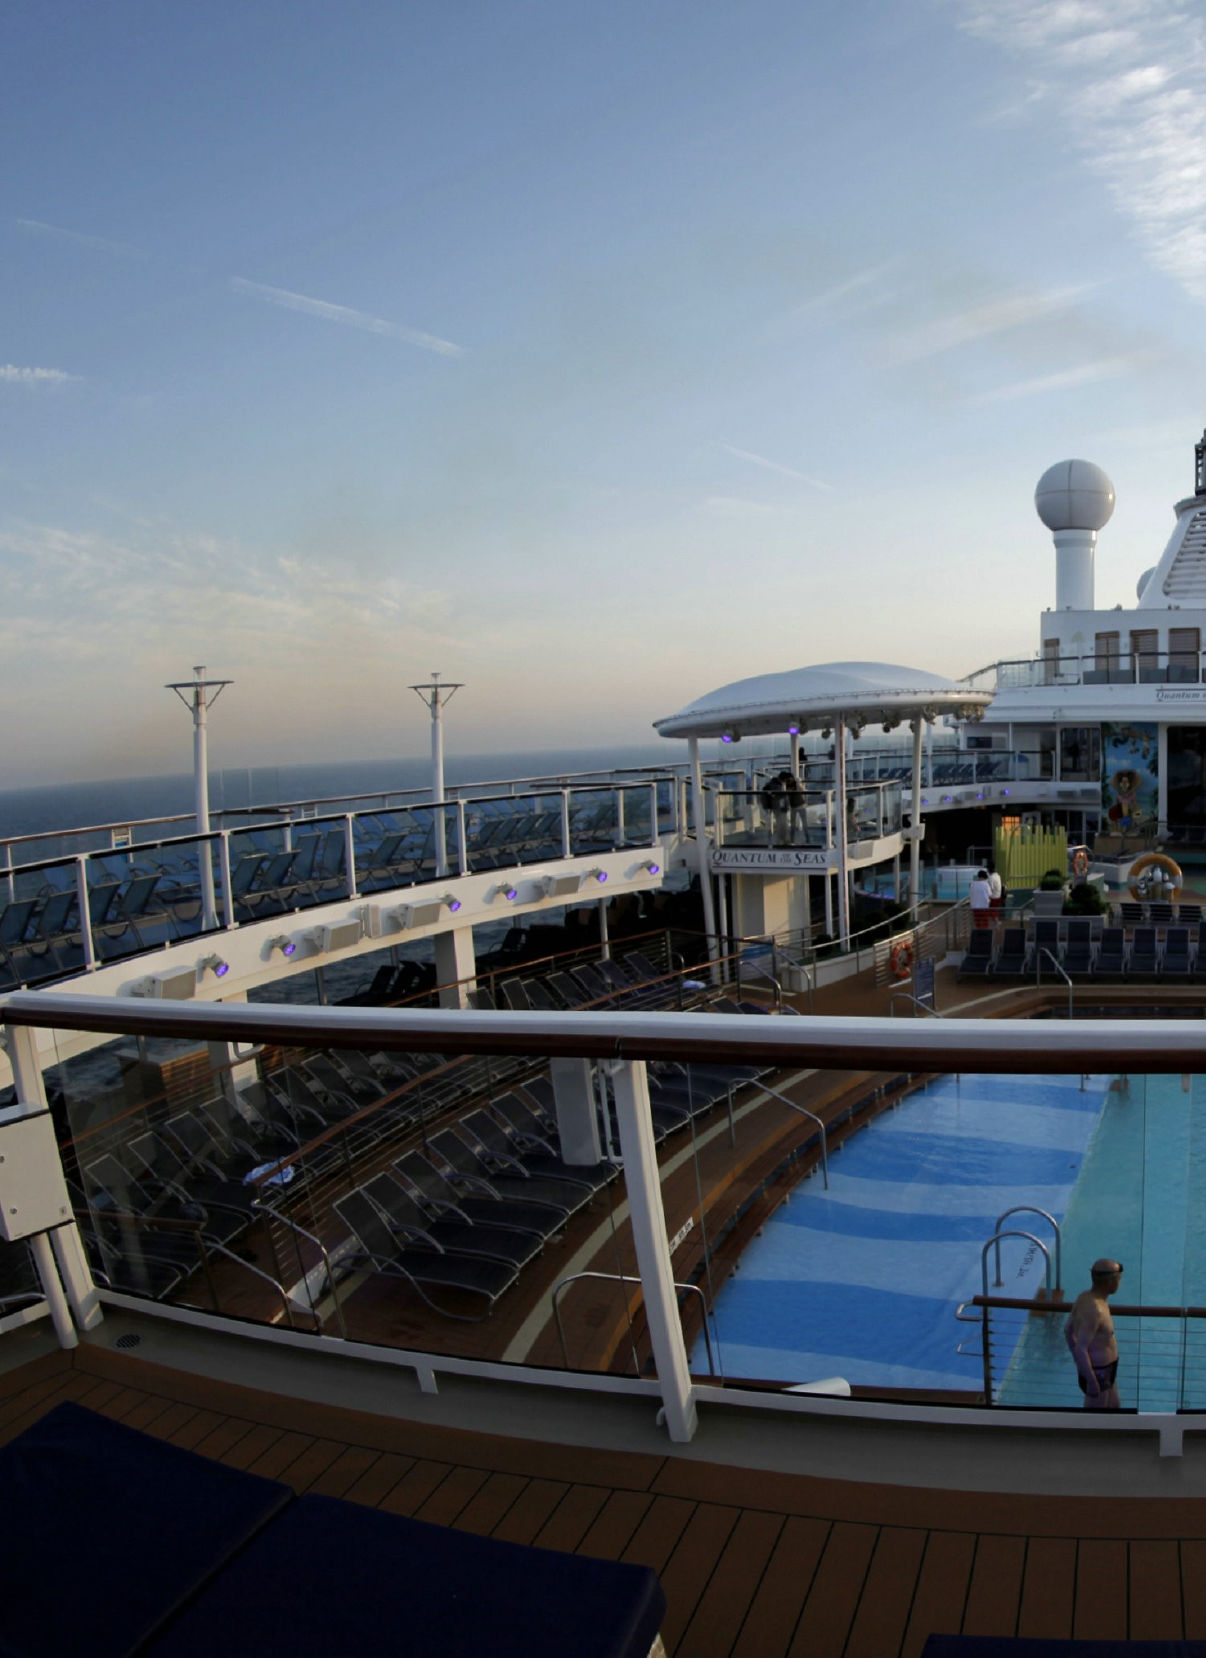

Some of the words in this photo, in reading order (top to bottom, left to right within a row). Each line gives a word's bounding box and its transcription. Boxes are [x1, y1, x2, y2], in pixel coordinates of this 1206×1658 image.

[1156, 691, 1200, 702] Quantum
[712, 851, 776, 865] QUANTUM
[794, 852, 826, 866] SEAS
